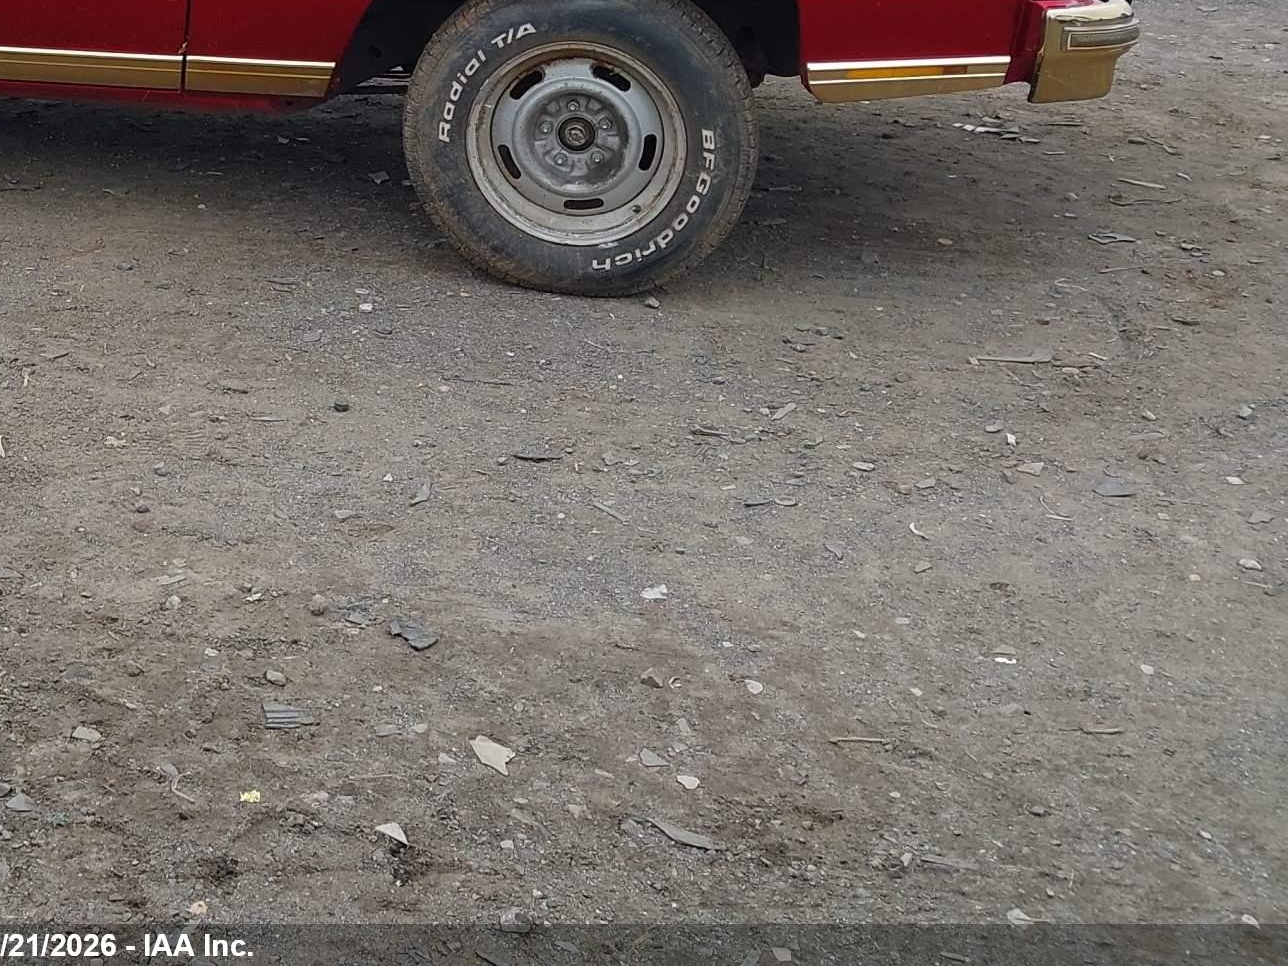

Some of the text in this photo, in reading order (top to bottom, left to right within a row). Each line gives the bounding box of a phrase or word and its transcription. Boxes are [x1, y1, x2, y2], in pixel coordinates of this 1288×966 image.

[438, 22, 538, 143] Radial T/A
[592, 128, 716, 271] BFGoodrich
